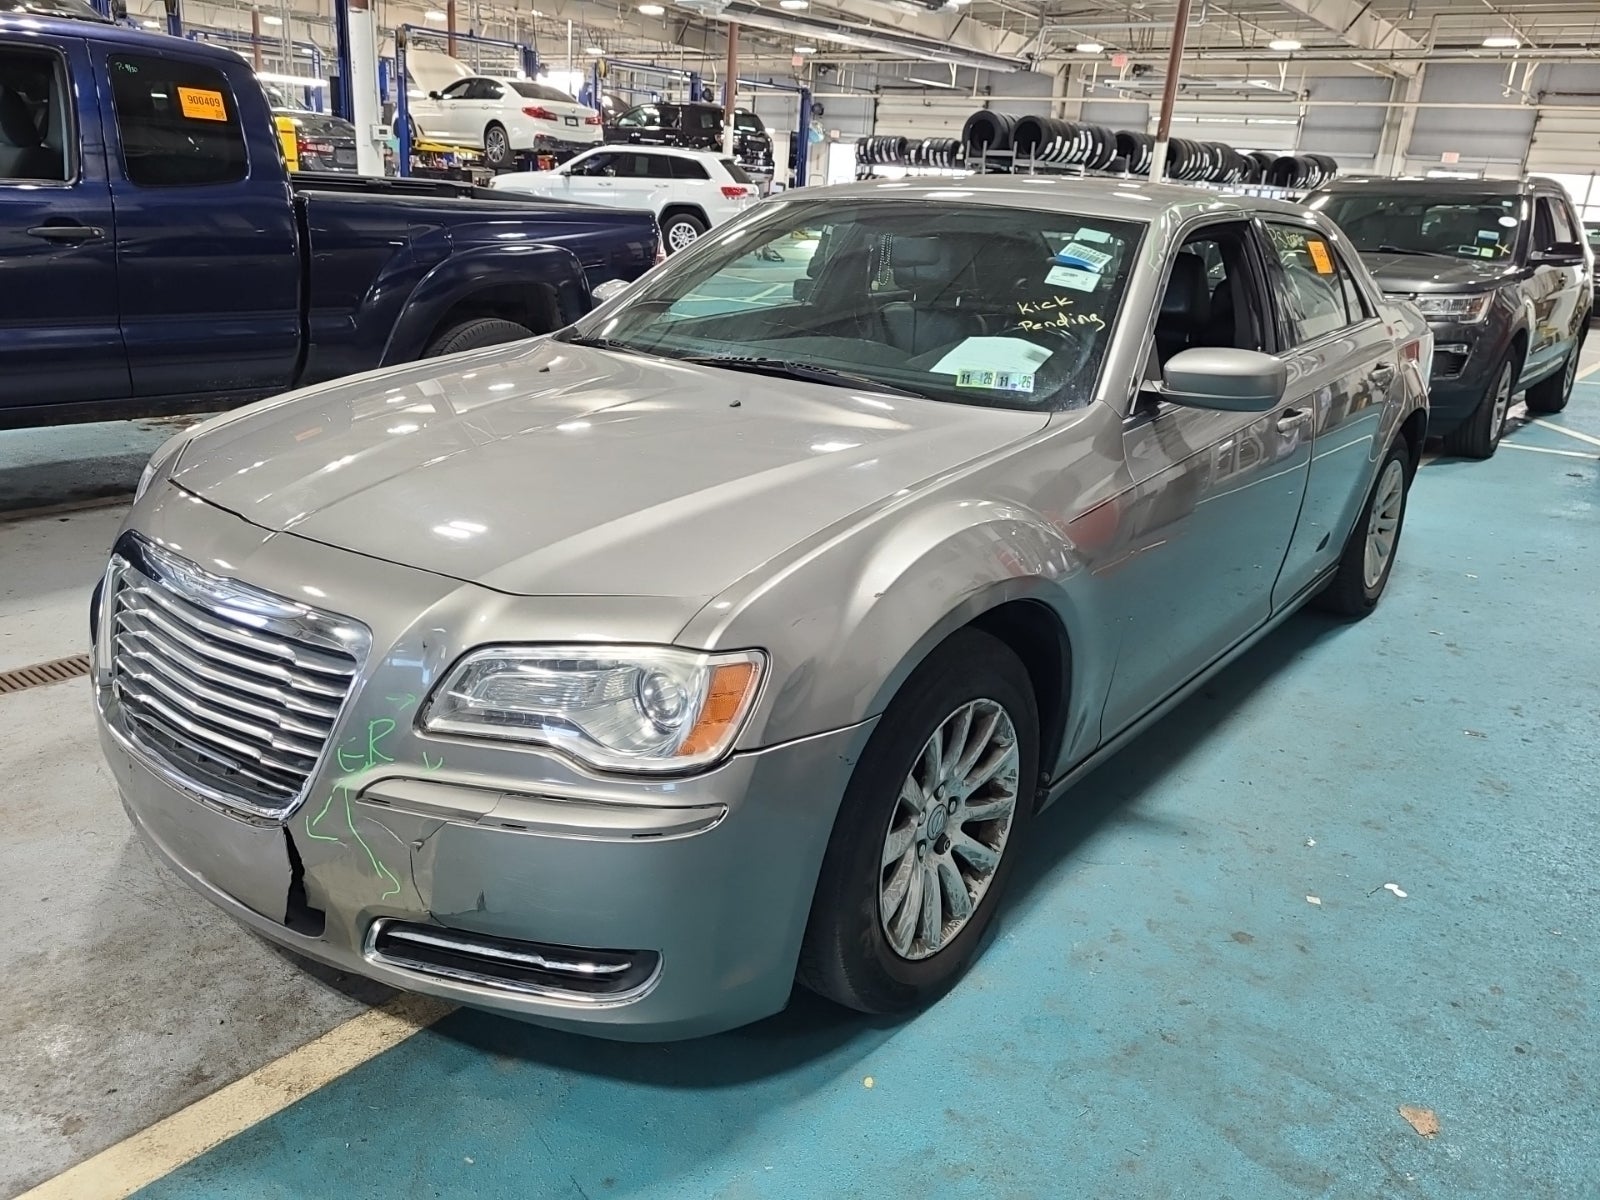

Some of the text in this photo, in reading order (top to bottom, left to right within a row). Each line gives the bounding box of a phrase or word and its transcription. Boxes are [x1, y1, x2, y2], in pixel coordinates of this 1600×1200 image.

[187, 94, 220, 108] 900409
[961, 372, 993, 385] 11 26
[999, 376, 1008, 387] 11
